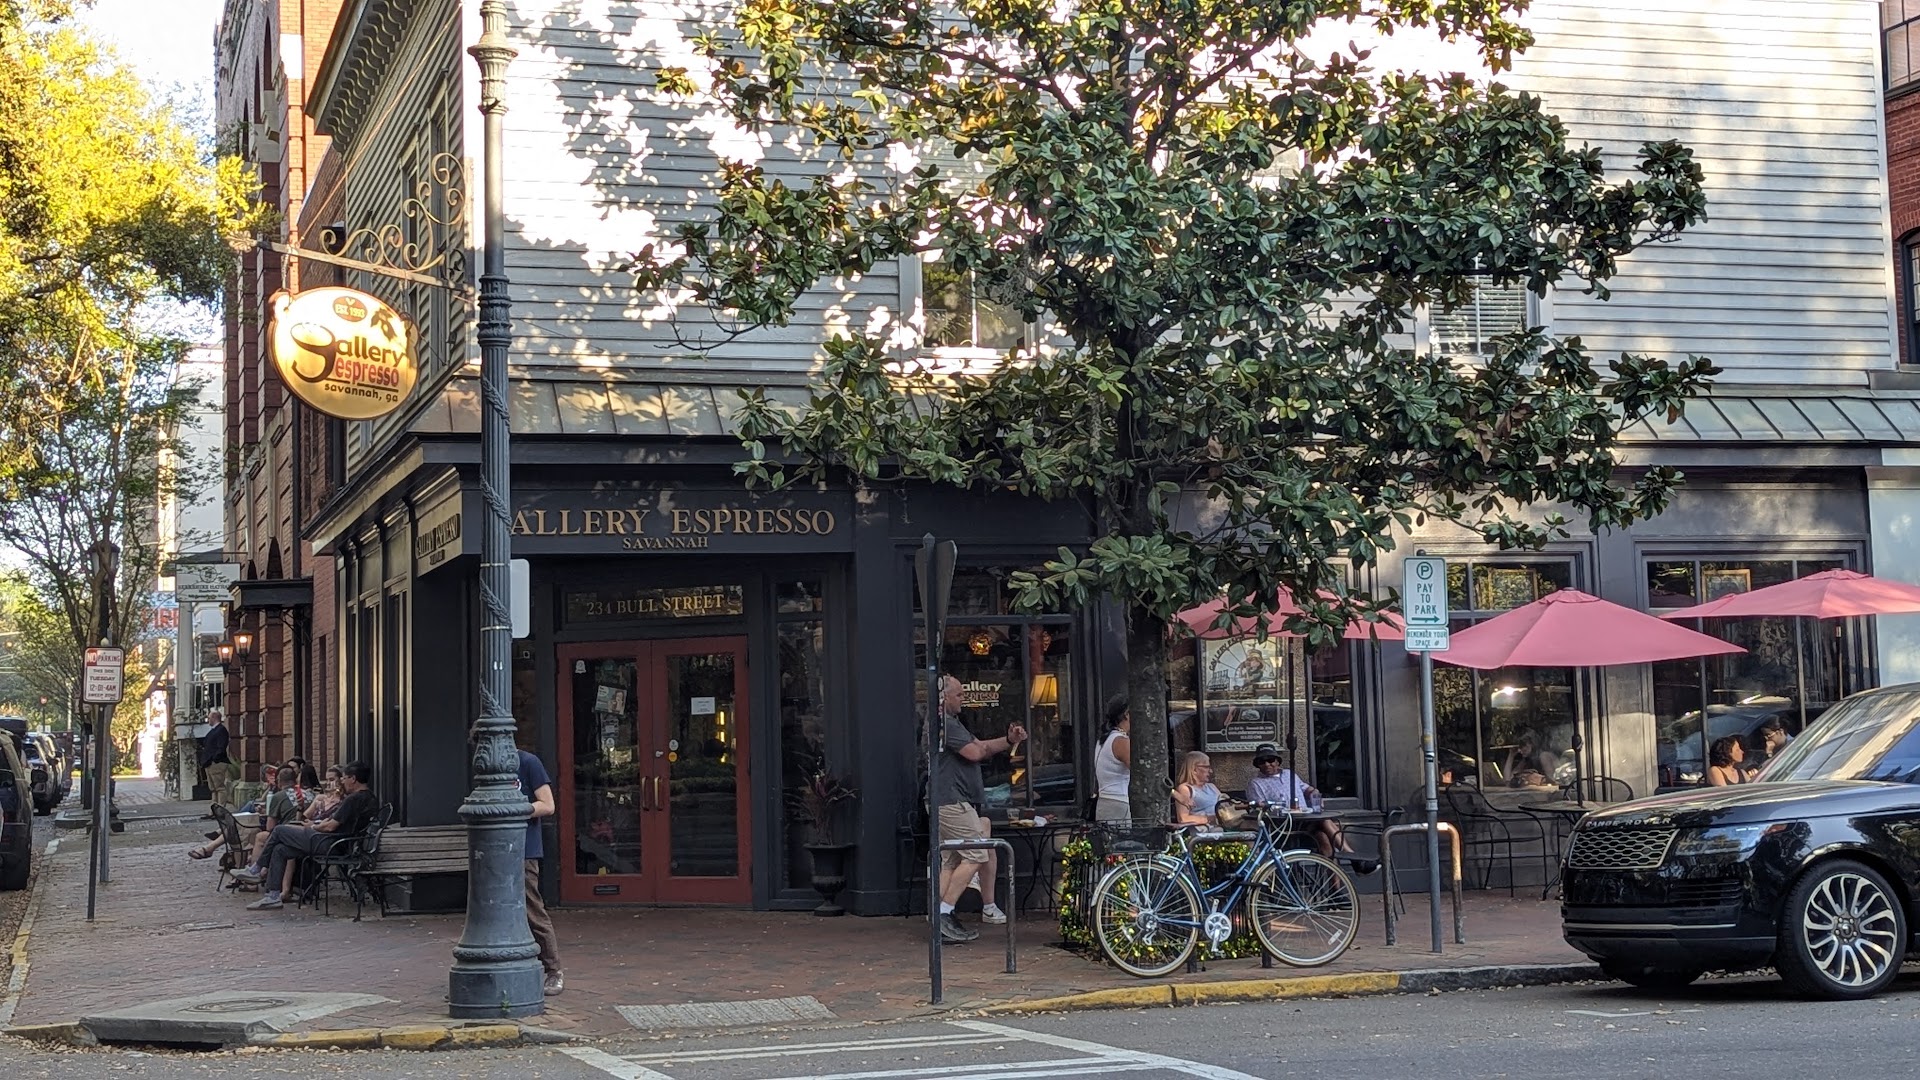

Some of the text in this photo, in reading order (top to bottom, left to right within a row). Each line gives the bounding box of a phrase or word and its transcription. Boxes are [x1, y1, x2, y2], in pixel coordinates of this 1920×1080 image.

[291, 322, 405, 383] Gallery
[335, 357, 399, 387] espresso
[324, 383, 398, 403] savannah, ga
[511, 508, 835, 535] ALLERY ESPRESSO
[622, 536, 709, 549] SAVANNAH
[1417, 583, 1433, 593] PAY
[587, 594, 724, 615] 234 BULL STREET
[1421, 594, 1431, 603] TO
[1415, 605, 1437, 614] PARK
[87, 652, 97, 663] NO
[961, 681, 1002, 691] allery
